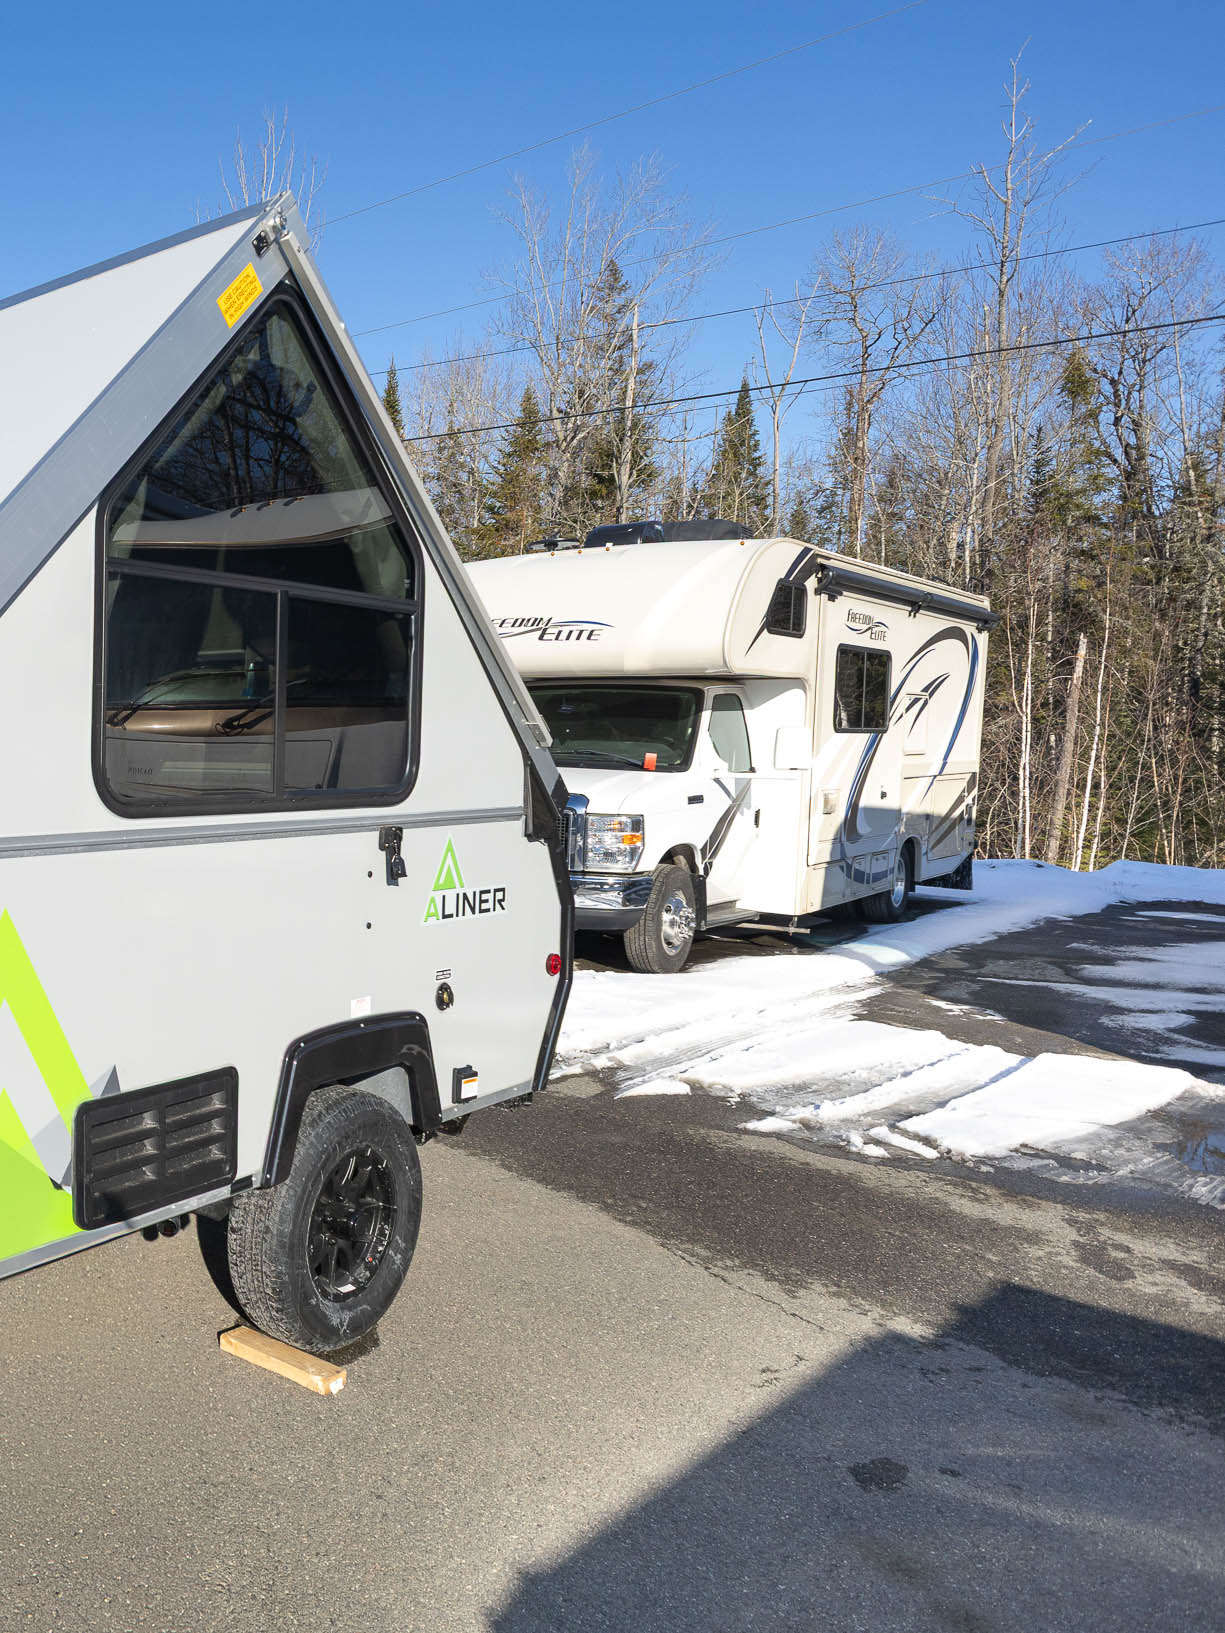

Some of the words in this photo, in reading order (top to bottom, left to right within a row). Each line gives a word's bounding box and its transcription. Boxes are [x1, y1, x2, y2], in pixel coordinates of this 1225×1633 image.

[847, 608, 874, 625] FREEDOM
[538, 627, 604, 641] ELITE
[869, 626, 887, 642] ELITE
[423, 887, 506, 923] ALINER
